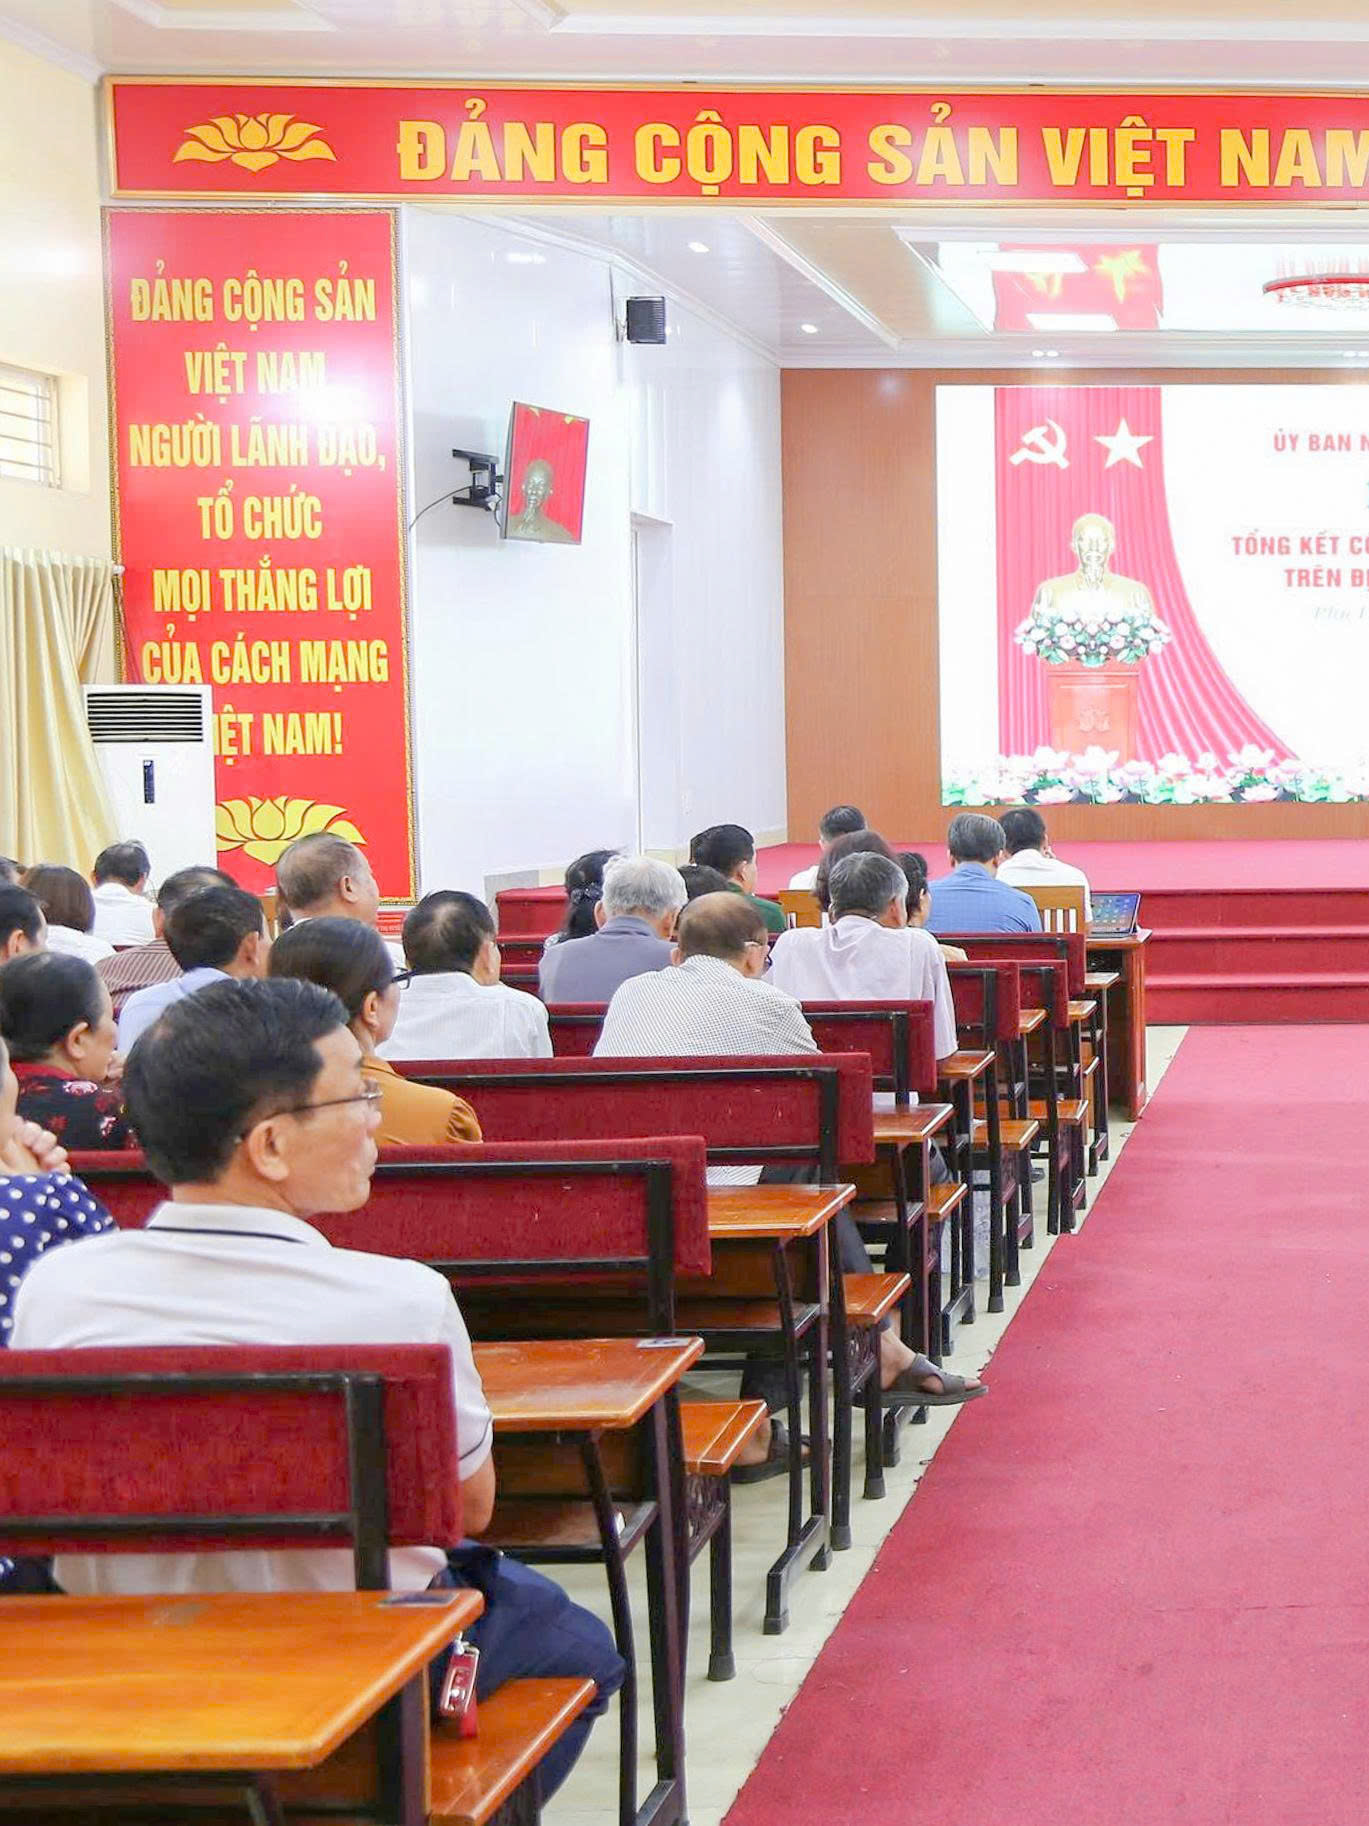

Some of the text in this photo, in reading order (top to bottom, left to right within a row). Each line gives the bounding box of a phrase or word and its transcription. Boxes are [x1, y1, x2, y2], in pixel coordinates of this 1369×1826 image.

[397, 97, 608, 184] ĐẢNG
[634, 109, 841, 195] CỘNG
[867, 102, 1018, 185] SẢN
[1042, 114, 1195, 196] VIỆT
[130, 259, 376, 331] ĐẢNG CỘNG SẢN
[184, 342, 327, 404] VIỆT NAM
[128, 412, 222, 467] NGƯỜI
[231, 416, 308, 467] LÃNH
[1308, 433, 1351, 452] BAN
[197, 479, 323, 539] TỔ CHỨC
[1232, 528, 1291, 555] TỔNG
[1300, 530, 1340, 555] KẾT
[153, 554, 372, 621] MỌI THẮNG LỢI
[1285, 565, 1341, 587] TRÊN
[142, 623, 389, 692] CỦA CÁCH MẠNG
[212, 704, 343, 765] IỆT NAM!
